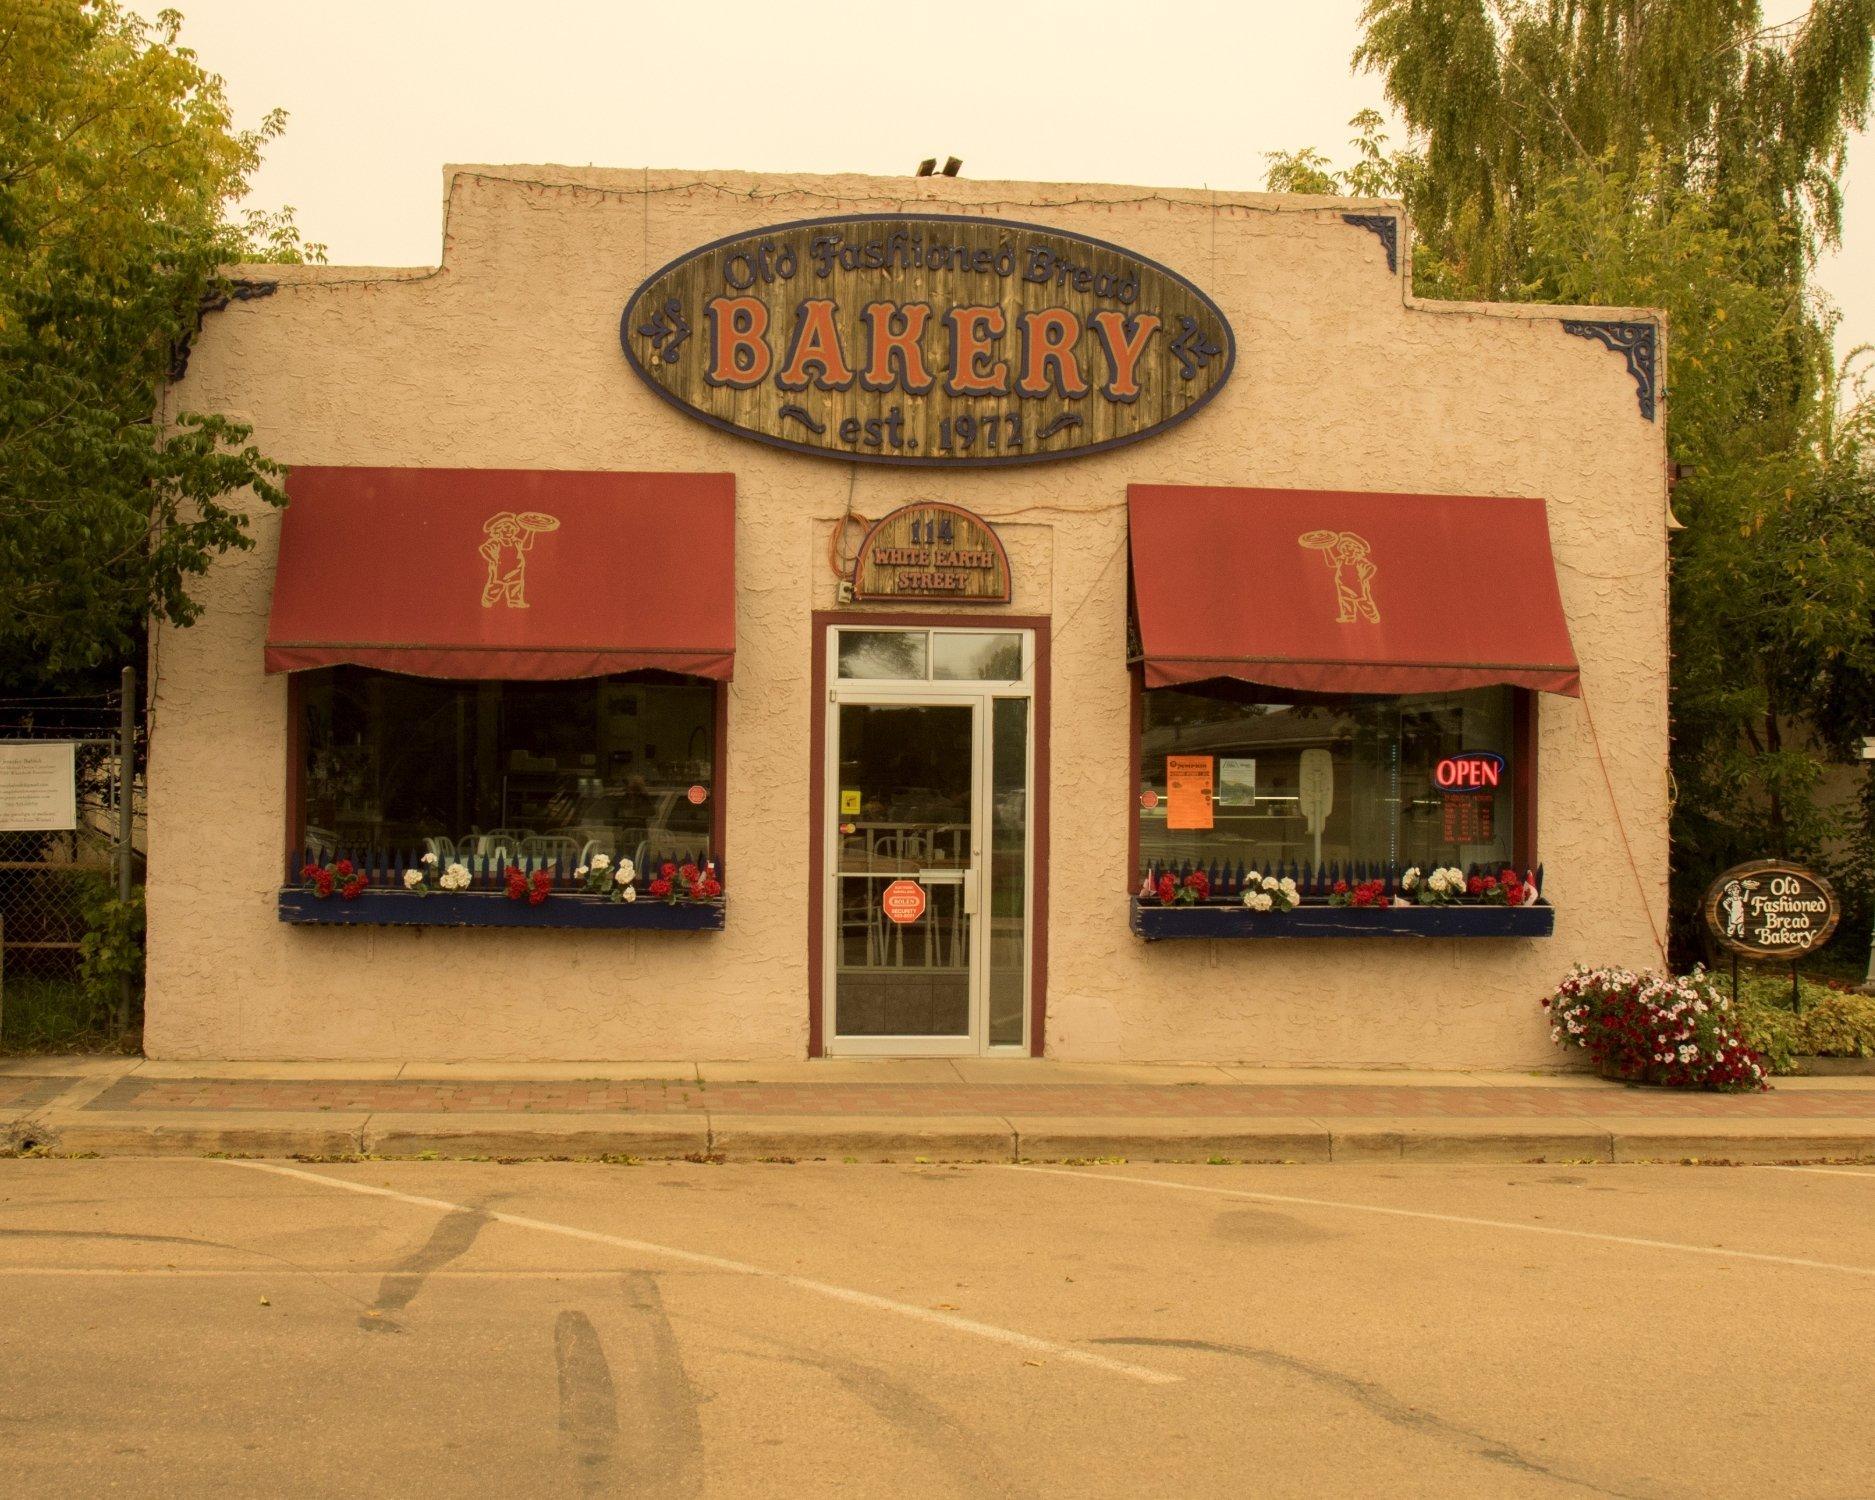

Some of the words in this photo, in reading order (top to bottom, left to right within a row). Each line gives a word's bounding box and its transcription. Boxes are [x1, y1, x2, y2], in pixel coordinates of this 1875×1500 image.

[724, 239, 797, 290] Old
[811, 231, 1016, 279] Fashioned
[1022, 244, 1140, 303] Bread
[704, 296, 1164, 402] BAKERY
[840, 407, 918, 449] est.
[939, 411, 1024, 451] 1972
[911, 517, 954, 545] 114
[873, 548, 930, 567] WHITE
[934, 549, 994, 569] EARTH
[899, 571, 969, 591] STREET
[1436, 760, 1498, 786] OPEN
[1770, 876, 1801, 896] Old
[1750, 896, 1827, 916] Fashioned
[1765, 913, 1810, 929] Bread
[1754, 928, 1817, 949] Bakery
